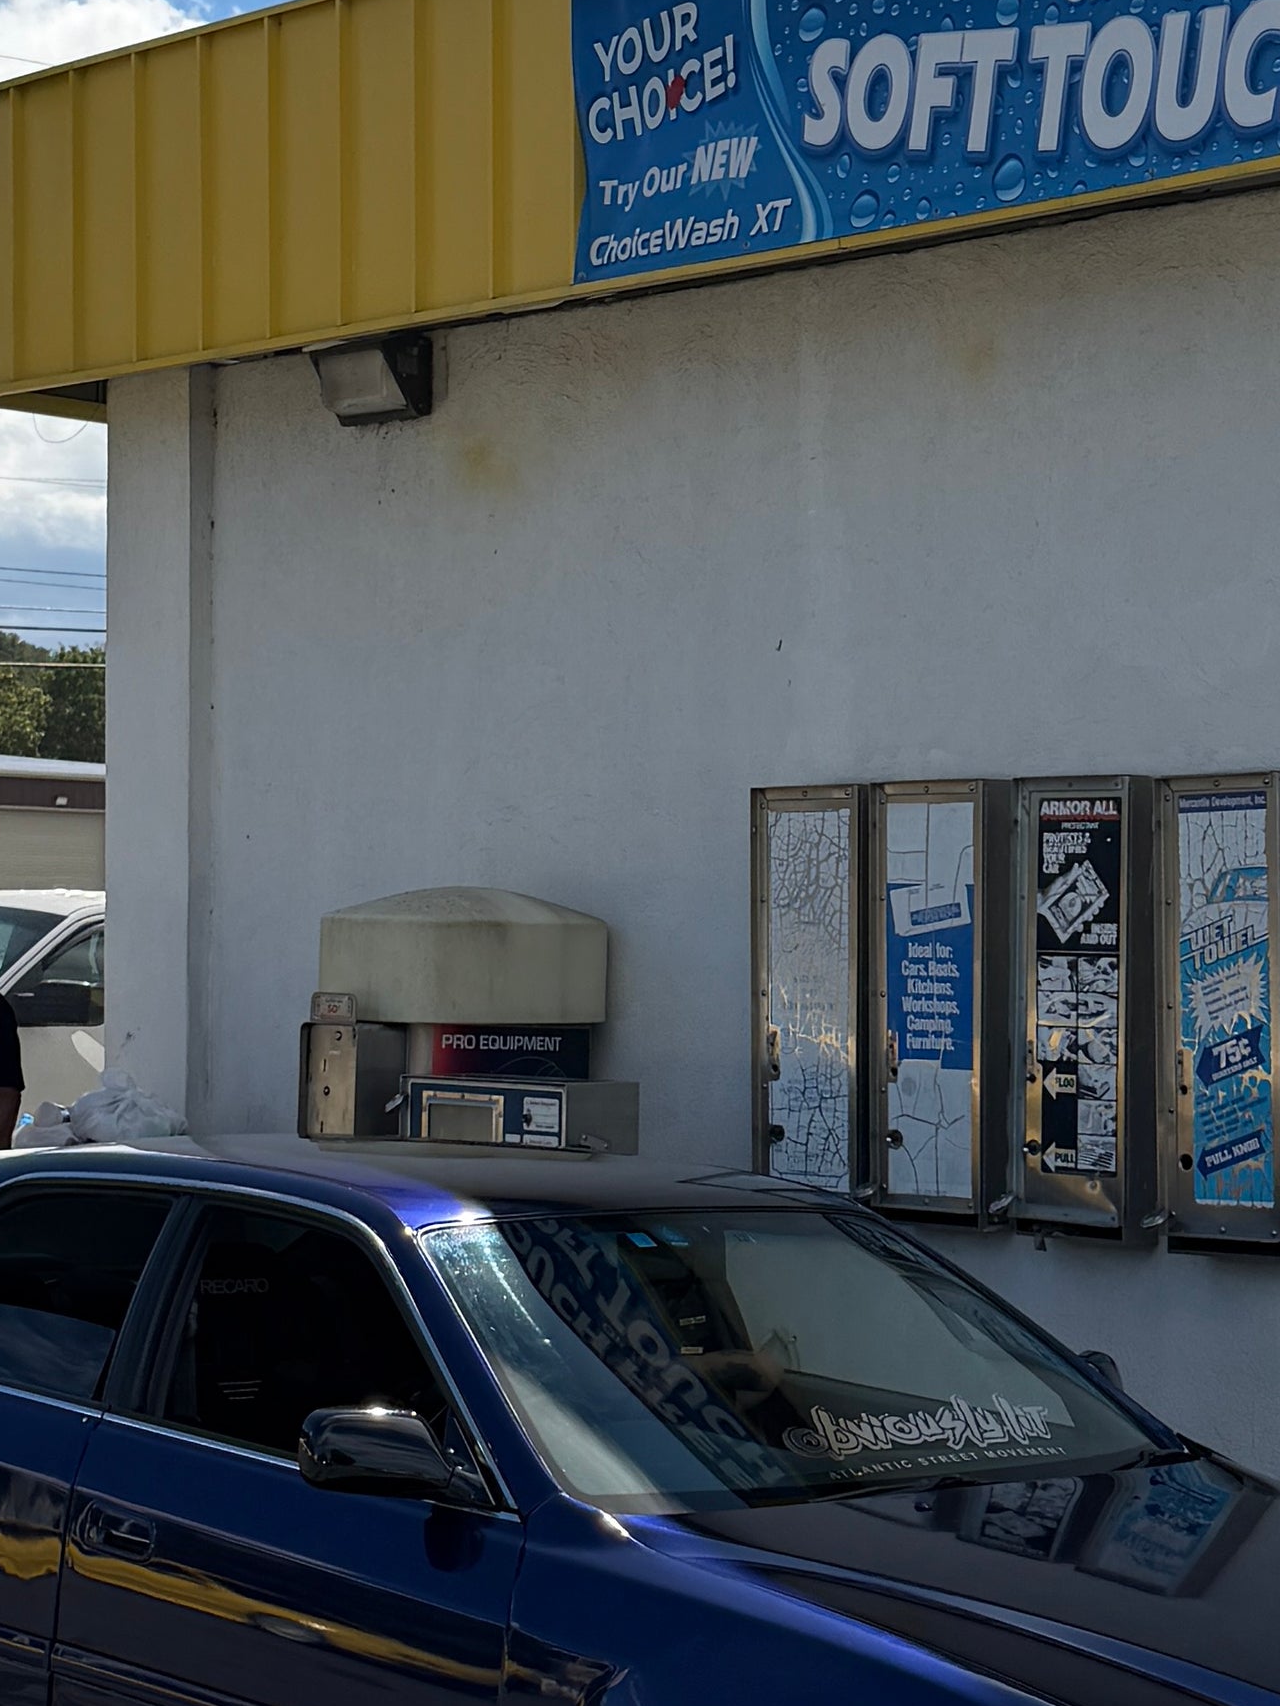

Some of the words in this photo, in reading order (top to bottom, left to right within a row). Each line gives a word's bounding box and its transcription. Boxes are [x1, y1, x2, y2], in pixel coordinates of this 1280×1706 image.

[593, 2, 698, 82] YOUR
[801, 25, 1020, 155] SOFT
[599, 180, 640, 212] Try
[642, 162, 687, 197] Our
[690, 136, 758, 185] NEW
[589, 209, 739, 266] ChoiceWash
[749, 198, 792, 236] XT
[1040, 800, 1090, 816] ARMOR
[1093, 800, 1117, 816] ALL
[1100, 933, 1117, 945] OUT
[1190, 916, 1233, 951] WET
[1193, 925, 1257, 970] TOWEL
[908, 943, 932, 958] Ideal
[441, 1034, 476, 1049] PRO
[479, 1035, 562, 1052] EQUIPMENT
[1212, 1037, 1252, 1069] 75¢
[1055, 1153, 1075, 1163] PULL
[1204, 1148, 1233, 1168] PULL
[200, 1277, 270, 1294] RECARO
[830, 1459, 912, 1481] ATLANTIC
[918, 1452, 978, 1467] STREET
[984, 1446, 1066, 1460] MOVEMENT
